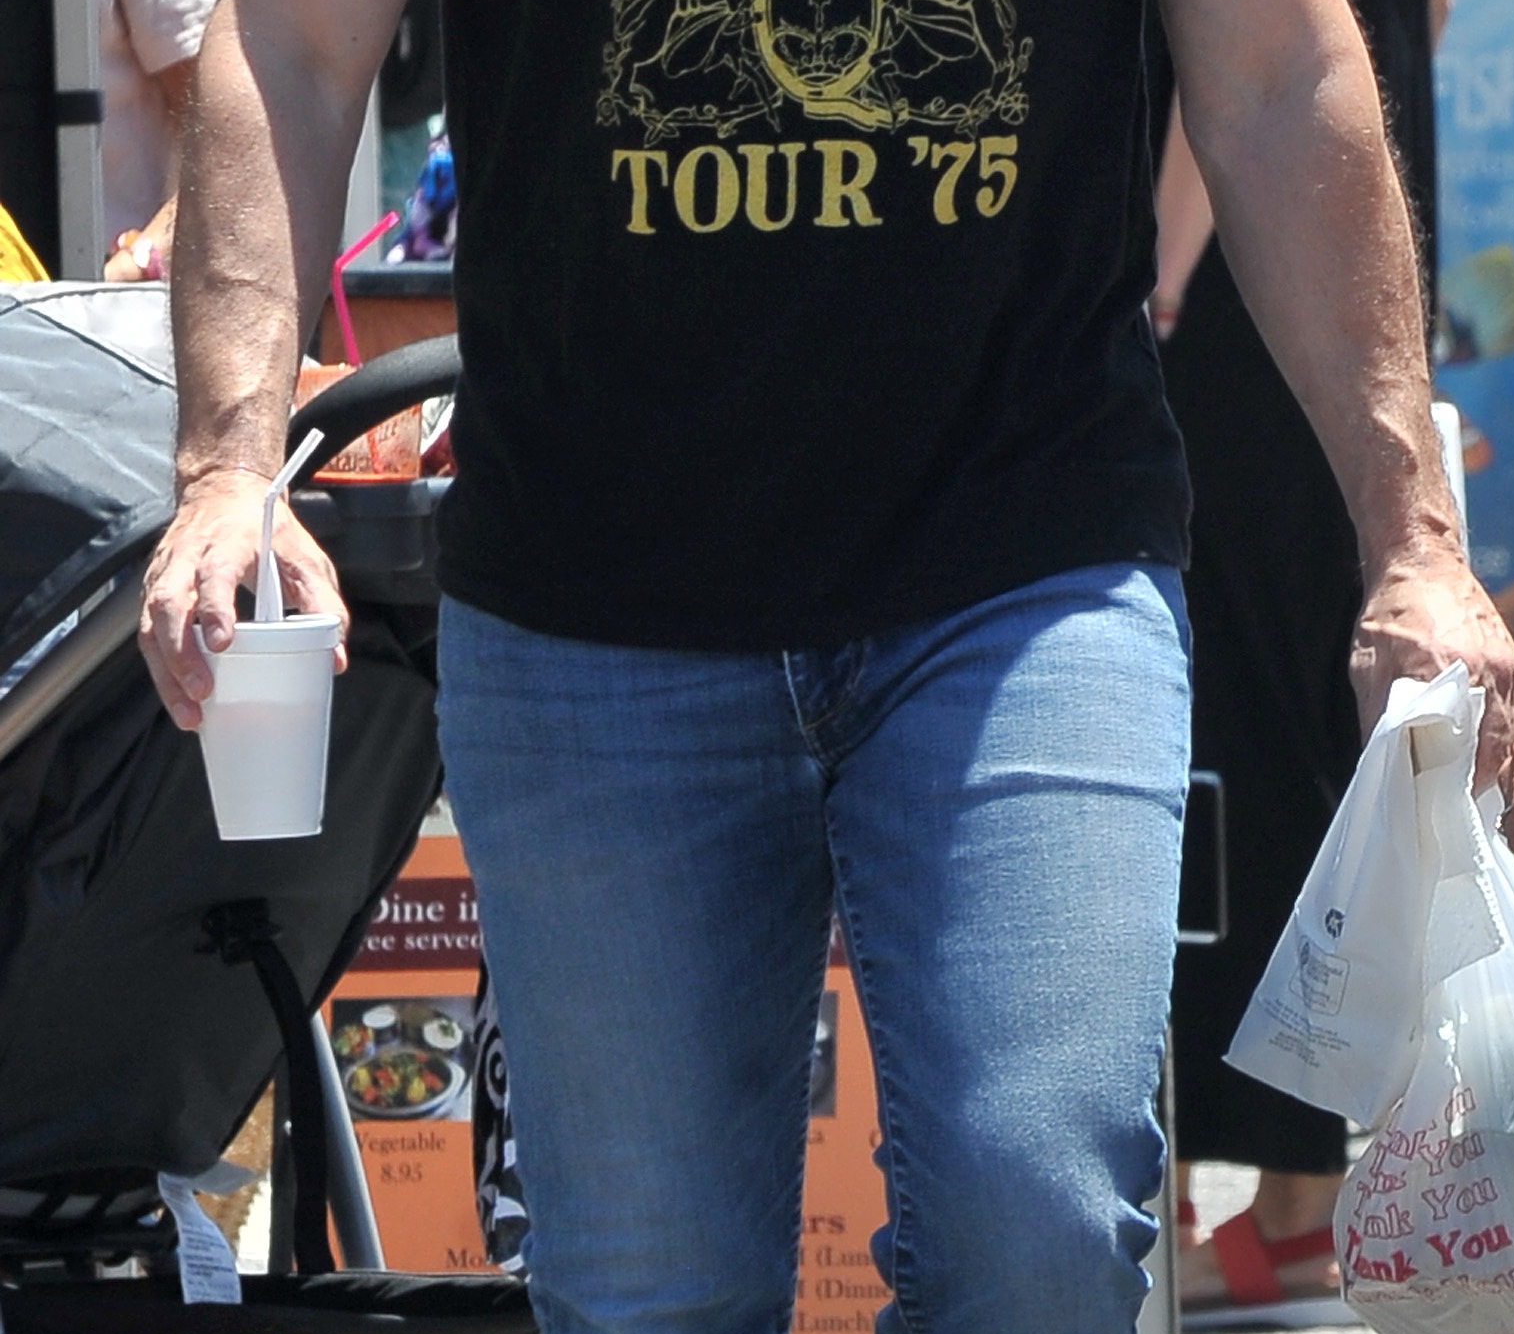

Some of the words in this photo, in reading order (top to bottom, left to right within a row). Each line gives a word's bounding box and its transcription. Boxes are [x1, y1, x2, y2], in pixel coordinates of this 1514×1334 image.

[611, 140, 883, 235] TOUR
[908, 135, 1018, 225] '75
[1420, 1132, 1486, 1176] You
[1421, 1177, 1499, 1221] You
[1426, 1224, 1513, 1267] You
